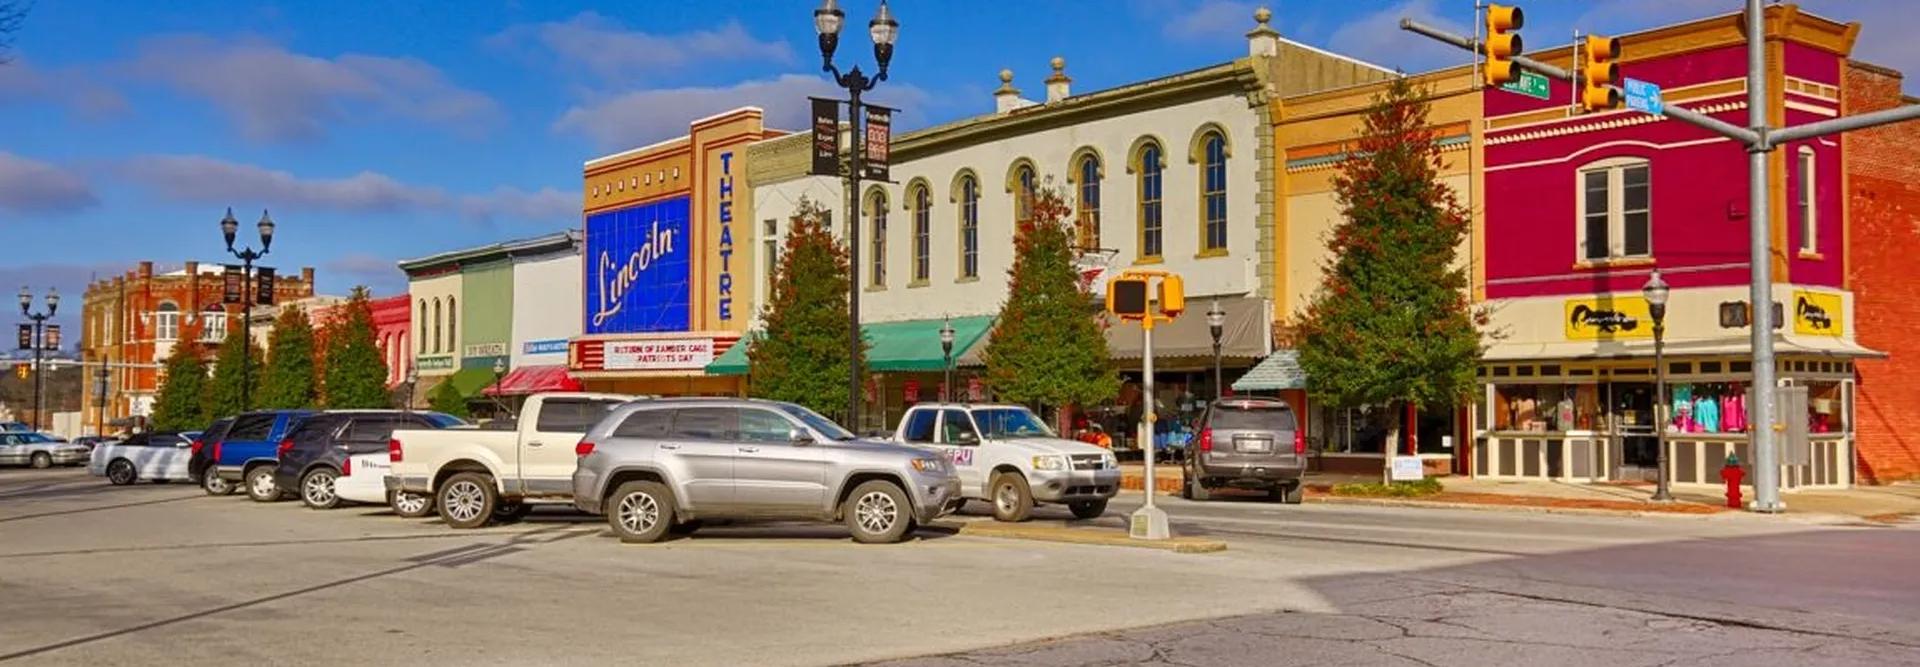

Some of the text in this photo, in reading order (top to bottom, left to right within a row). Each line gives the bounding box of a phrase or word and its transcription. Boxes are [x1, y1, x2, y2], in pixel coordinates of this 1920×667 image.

[719, 152, 733, 320] THEATRE
[593, 221, 673, 327] Lincoln
[645, 345, 655, 353] OF
[678, 354, 694, 362] DAY
